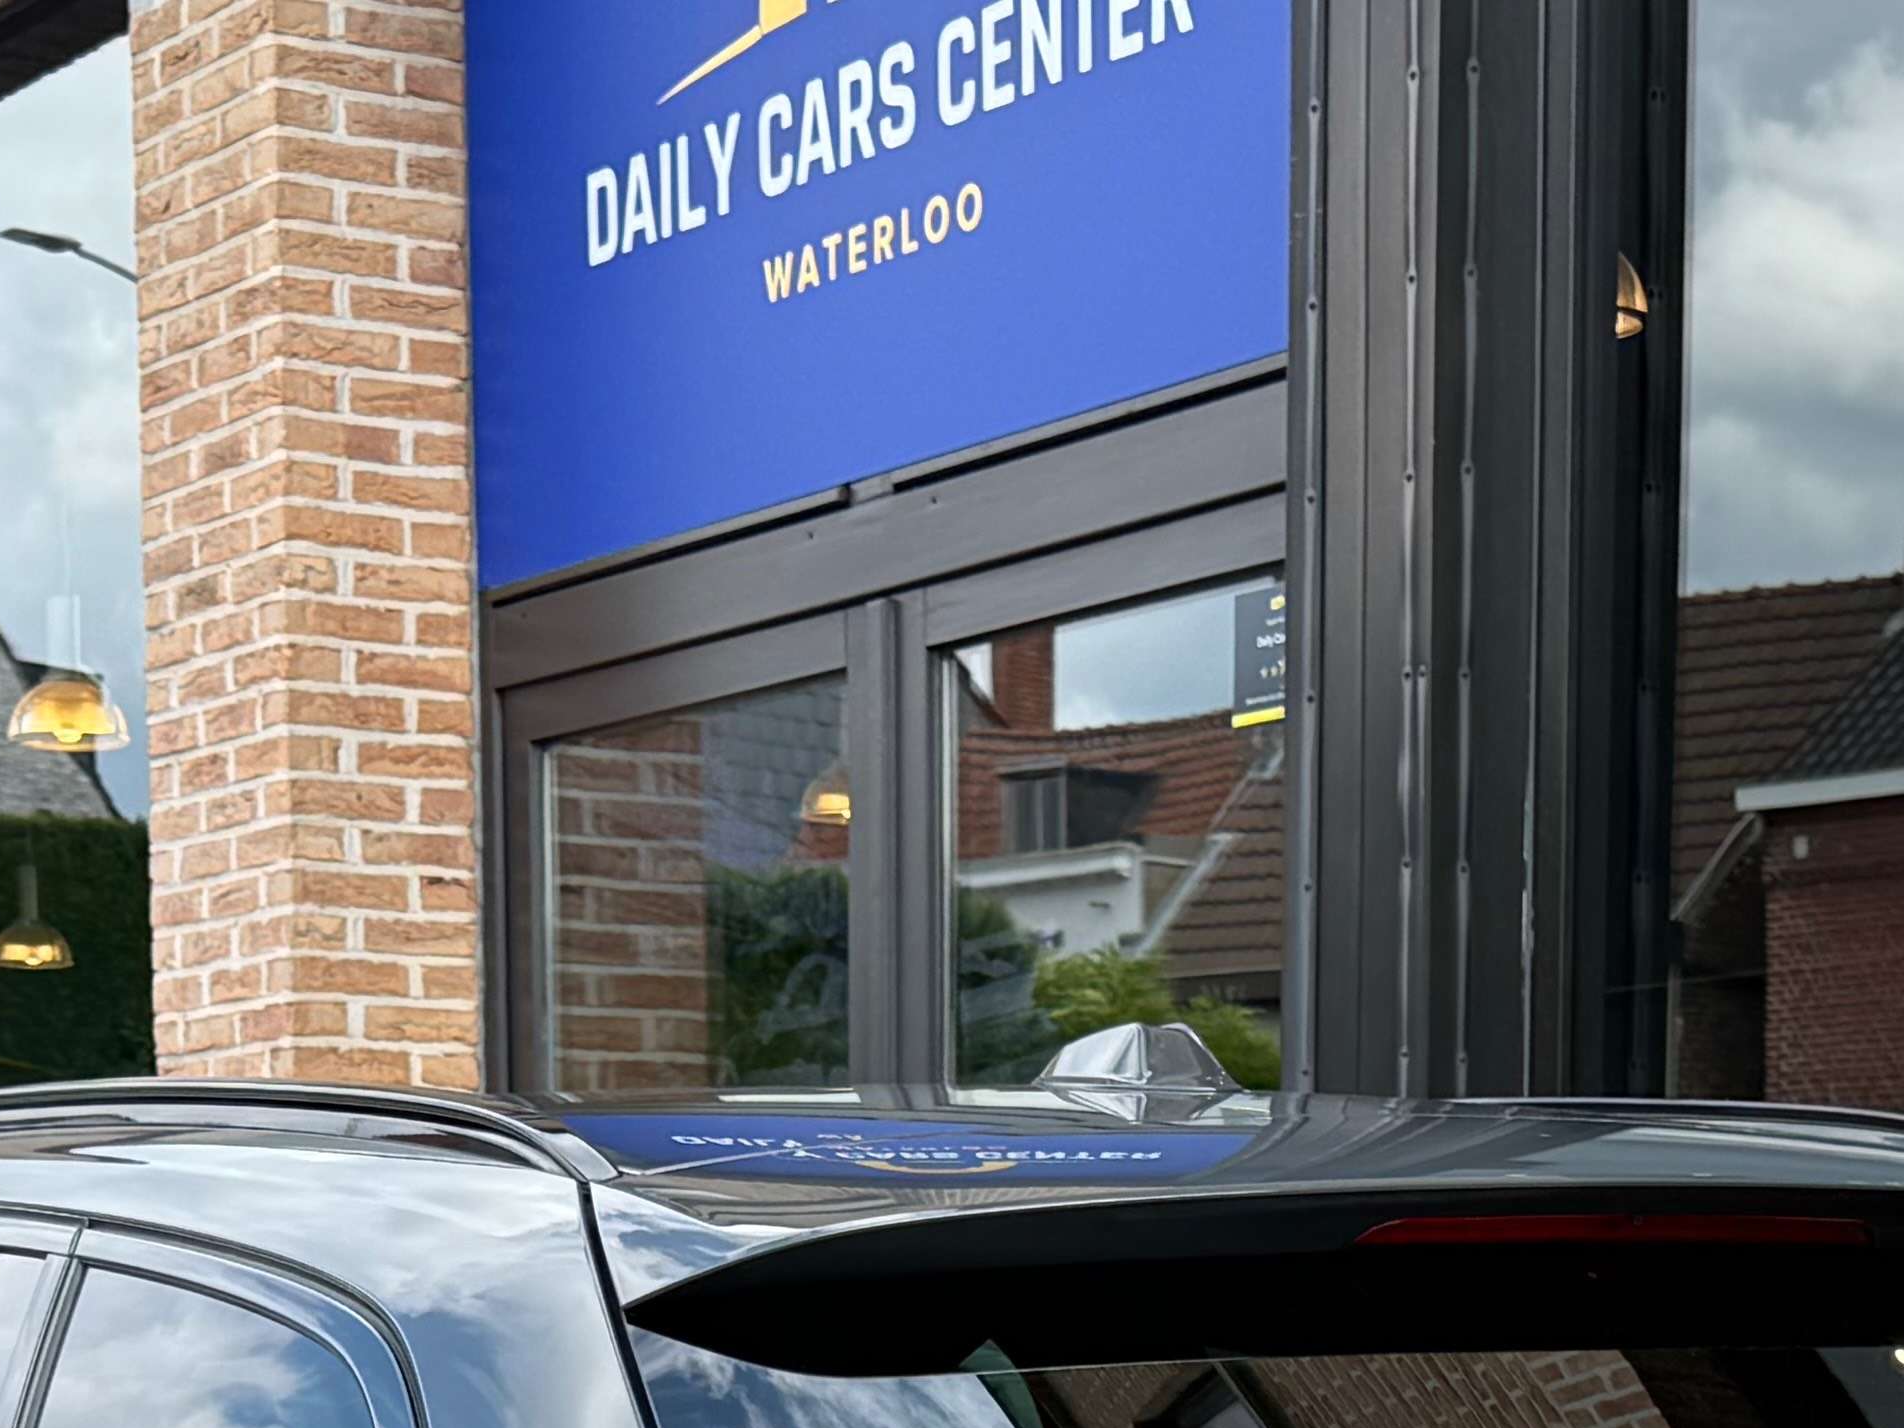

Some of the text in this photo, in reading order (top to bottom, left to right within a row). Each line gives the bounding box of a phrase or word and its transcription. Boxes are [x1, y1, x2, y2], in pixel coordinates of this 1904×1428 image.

[585, 110, 741, 268] DAILY
[756, 40, 917, 199] CARS
[762, 182, 985, 305] WATERLOO
